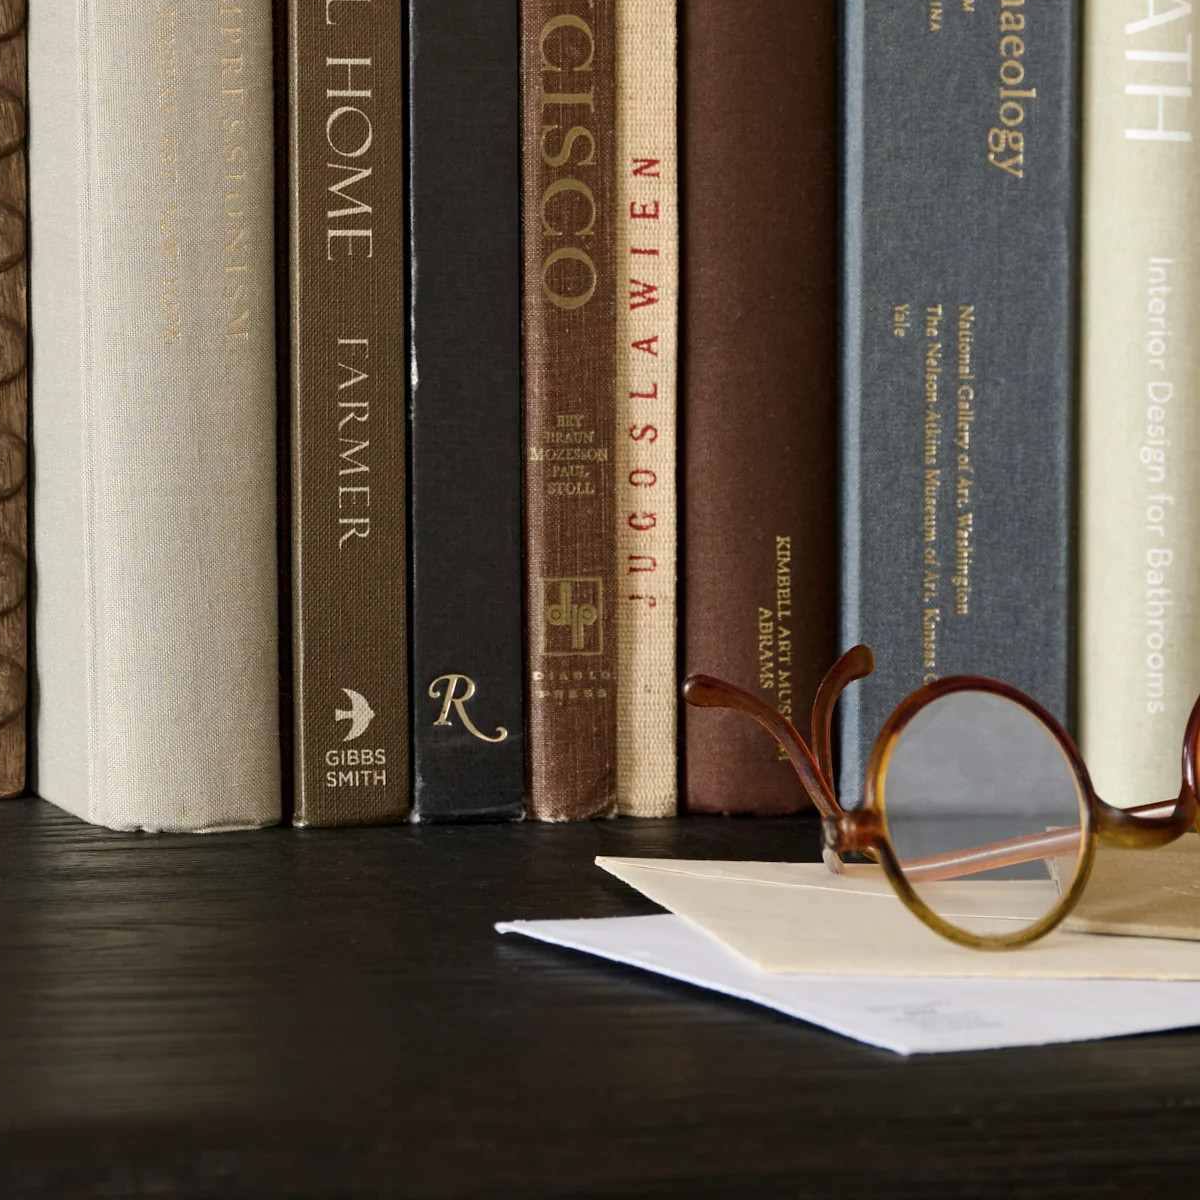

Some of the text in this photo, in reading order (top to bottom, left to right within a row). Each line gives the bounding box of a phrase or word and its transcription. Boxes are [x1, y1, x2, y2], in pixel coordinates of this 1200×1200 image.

[325, 56, 373, 261] HOME
[893, 304, 910, 337] Yale
[925, 304, 942, 336] The
[957, 305, 974, 380] National
[627, 157, 660, 608] JUGOSLAWIEN
[924, 343, 942, 465] Nelson-Atkins
[953, 385, 974, 449] Gallery
[337, 337, 371, 550] FARMER
[957, 453, 973, 472] of
[923, 469, 940, 541] Museum
[1140, 256, 1173, 714] Interior Design for Bathrooms
[924, 547, 940, 567] of
[952, 513, 973, 615] Washington
[758, 607, 774, 689] ABRAMS
[775, 536, 792, 761] KIMBELL ART MUSM
[922, 608, 940, 668] Kansas
[428, 673, 508, 743] R
[325, 749, 386, 766] GIBBS
[326, 770, 387, 787] SMITH
